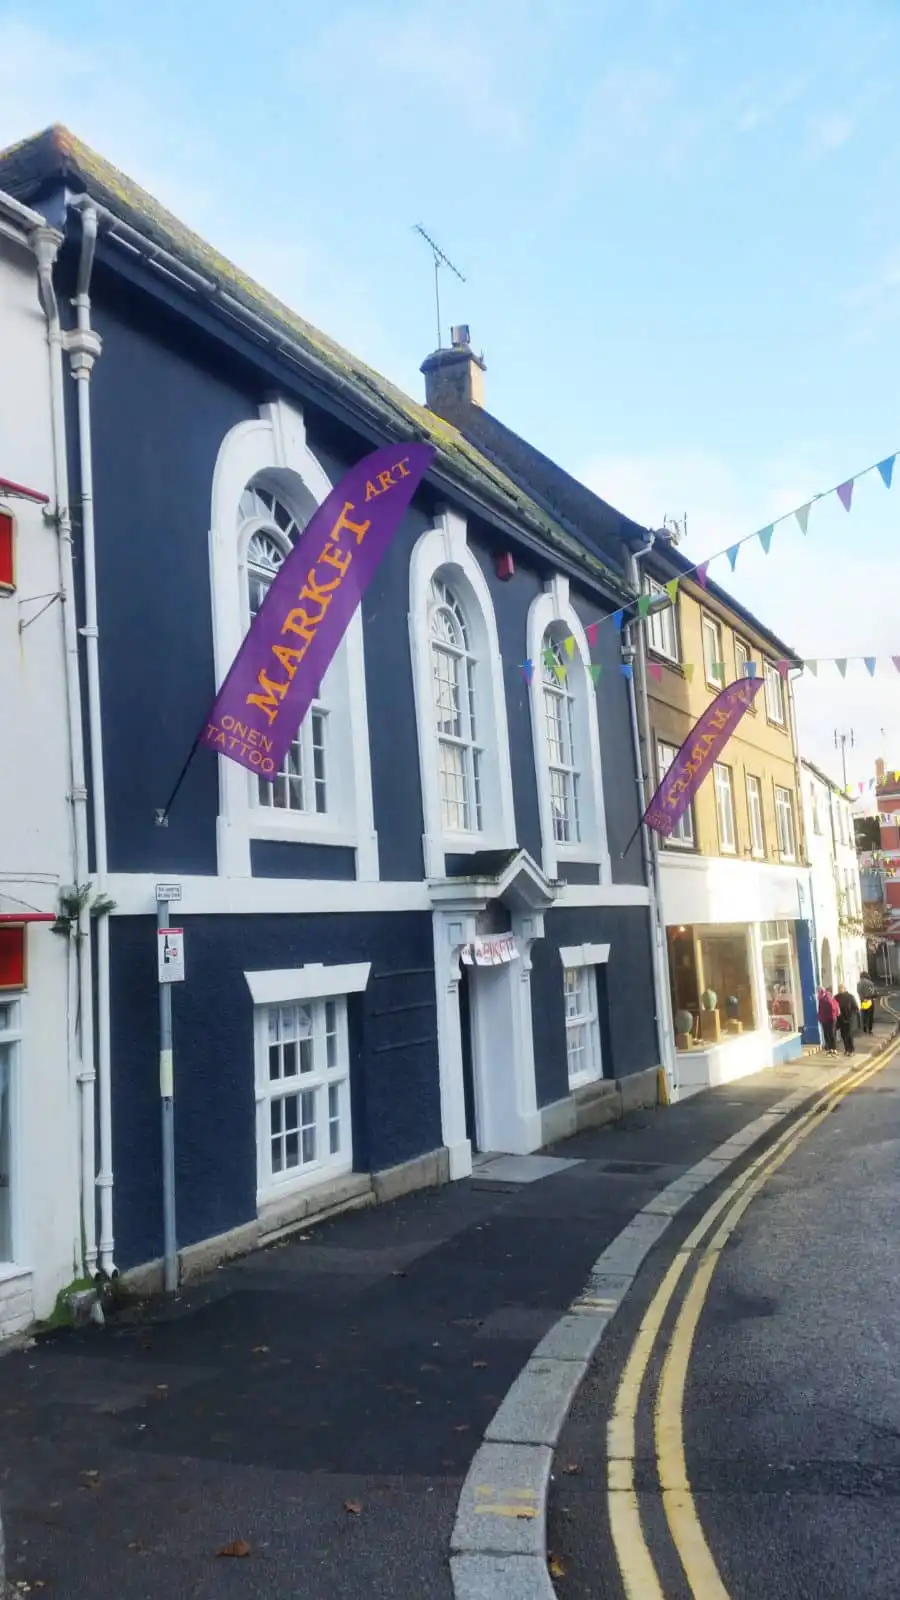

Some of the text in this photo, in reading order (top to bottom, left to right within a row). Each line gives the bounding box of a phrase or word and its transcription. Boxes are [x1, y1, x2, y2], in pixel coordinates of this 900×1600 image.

[363, 456, 411, 503] ART
[245, 501, 371, 725] MARKET
[206, 722, 276, 773] TATTOO
[220, 713, 275, 754] ONEN
